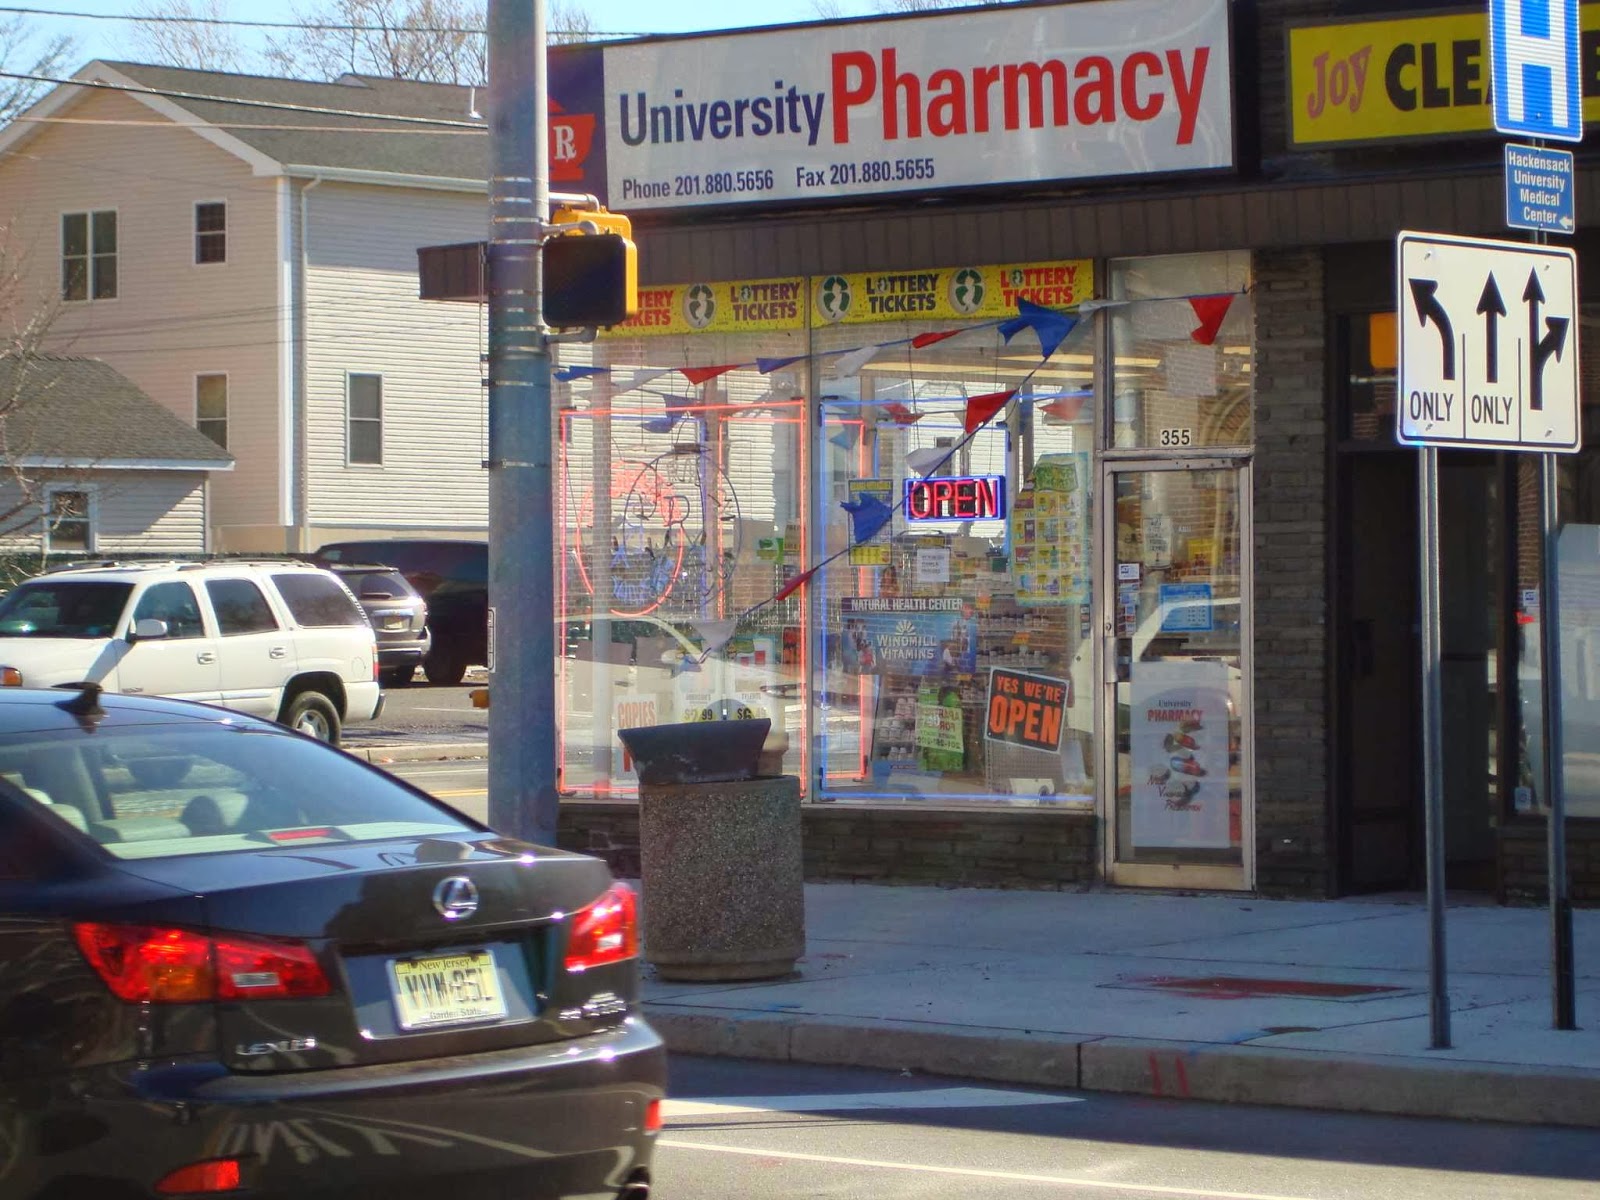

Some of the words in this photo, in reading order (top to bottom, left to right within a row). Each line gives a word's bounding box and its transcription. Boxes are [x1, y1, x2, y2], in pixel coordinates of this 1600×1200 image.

[1306, 44, 1373, 120] Joy
[1385, 38, 1491, 112] CLE
[620, 80, 825, 146] University
[831, 46, 1210, 145] Pharmacy
[1508, 151, 1570, 173] Hackensack
[622, 179, 671, 200] Phone
[675, 169, 774, 196] 201.880.5656
[796, 165, 825, 187] Fax
[830, 157, 935, 185] 201.880.5655
[1514, 169, 1565, 193] University
[1520, 188, 1560, 207] Medical
[1523, 206, 1558, 224] Center
[866, 273, 940, 295] LOTTERY
[1000, 266, 1078, 288] LOTTERY
[637, 289, 674, 308] TERY
[730, 281, 801, 303] LOTTERY
[1003, 285, 1073, 307] TICKETS
[732, 301, 797, 322] TICKETS
[869, 292, 936, 315] TICKETS
[624, 308, 672, 327] KETS
[1410, 390, 1453, 422] ONLY
[1471, 394, 1513, 425] ONLY
[1161, 430, 1190, 446] 355
[910, 479, 997, 519] OPEN
[851, 598, 892, 612] NATURAL
[892, 598, 927, 611] HEALTH
[928, 597, 963, 611] CENTER
[876, 634, 938, 647] WINDMILL
[880, 647, 935, 660] VITAMINS
[996, 675, 1019, 694] YES
[1024, 681, 1063, 703] WE'RE
[617, 701, 657, 728] COPIES
[989, 694, 1062, 745] OPEN
[419, 960, 441, 971] New
[442, 958, 471, 971] Jersey
